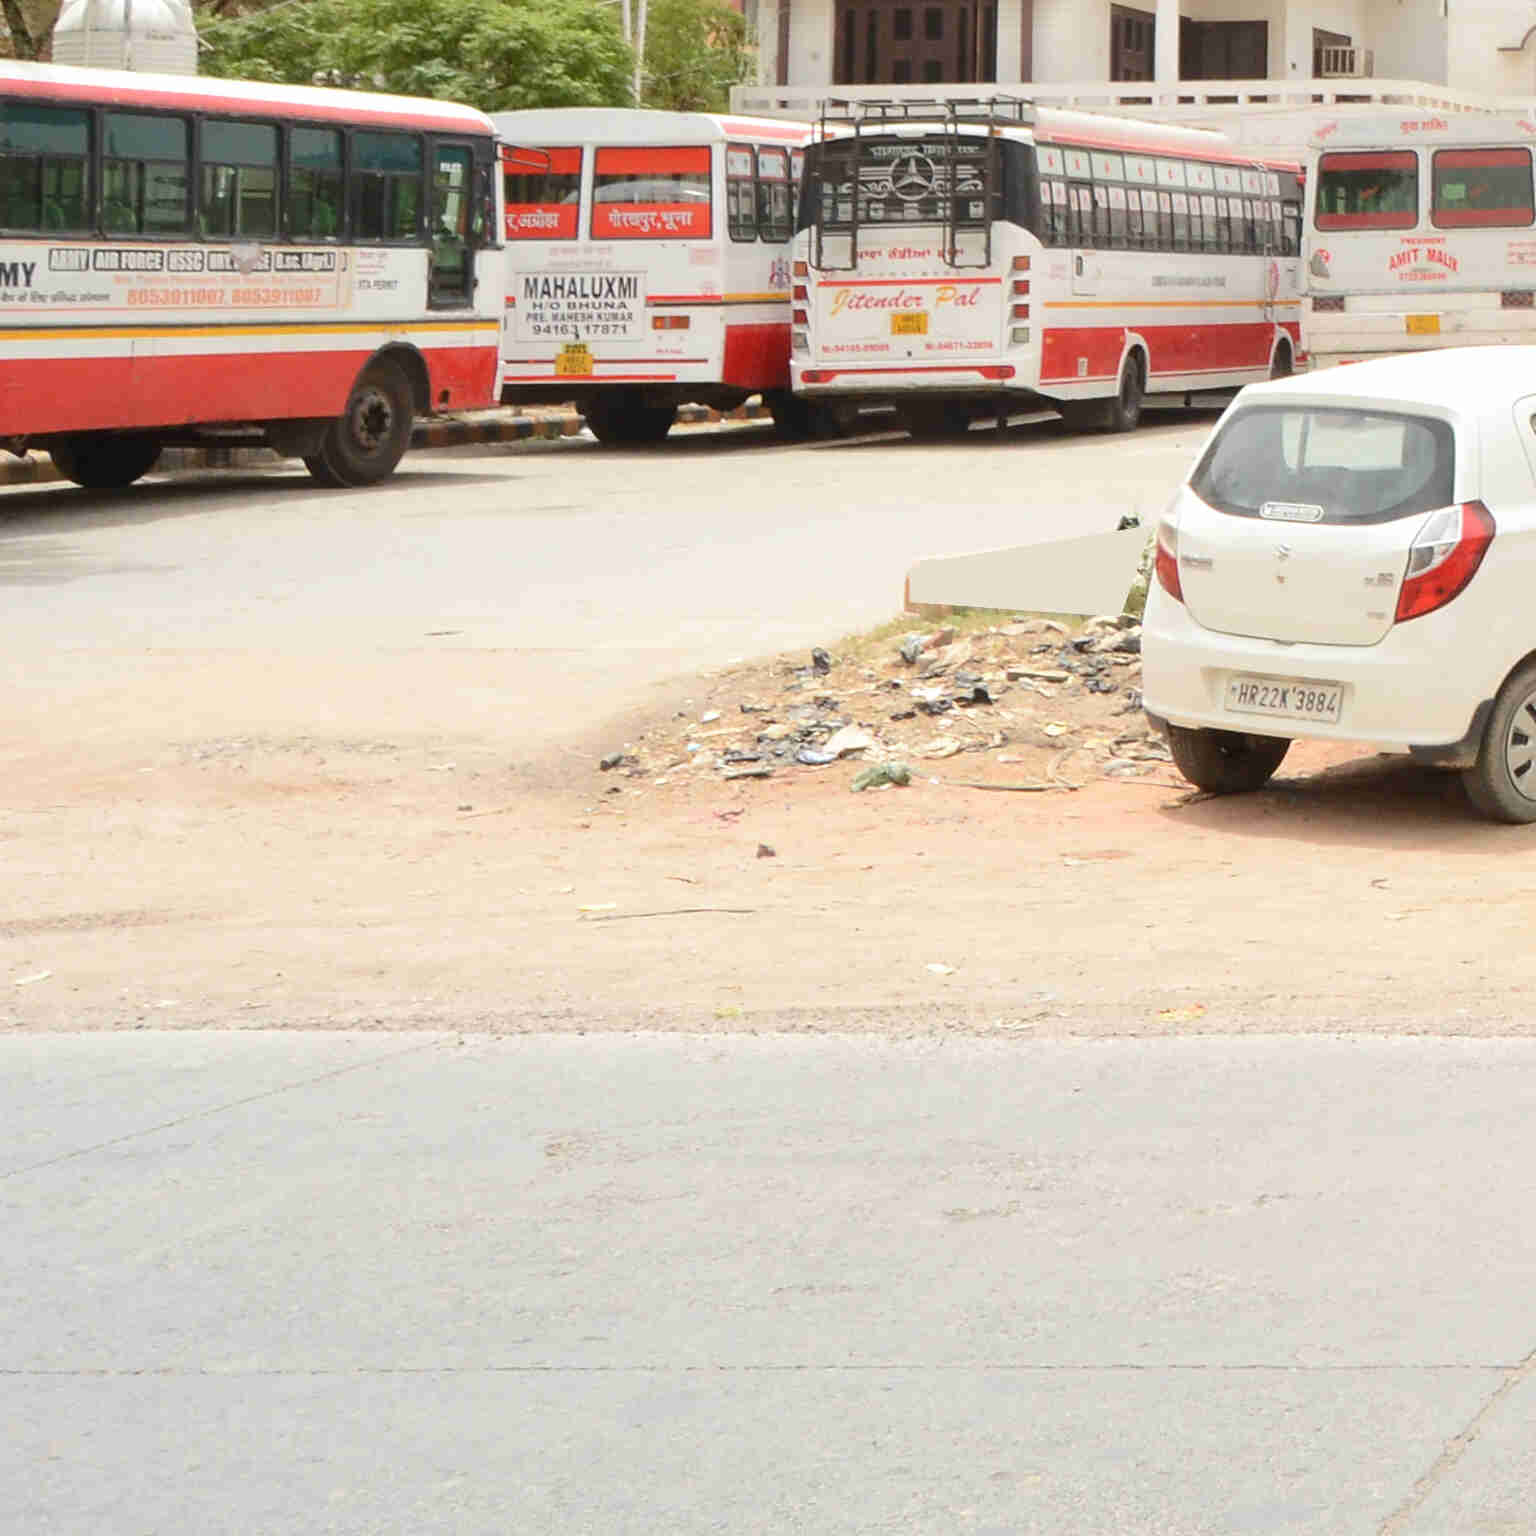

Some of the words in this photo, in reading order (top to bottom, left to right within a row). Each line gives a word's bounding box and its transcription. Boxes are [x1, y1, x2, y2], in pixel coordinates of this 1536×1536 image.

[95, 251, 120, 270] AIR
[121, 252, 163, 271] FORCE
[1389, 248, 1419, 271] AMIT
[523, 276, 638, 300] MAHALUXMI
[567, 301, 628, 311] BHUNA
[831, 287, 923, 319] Jitender
[935, 284, 981, 309] Pal
[551, 312, 593, 322] MAHESH
[596, 312, 633, 322] KUMAR
[585, 324, 628, 336] 17871
